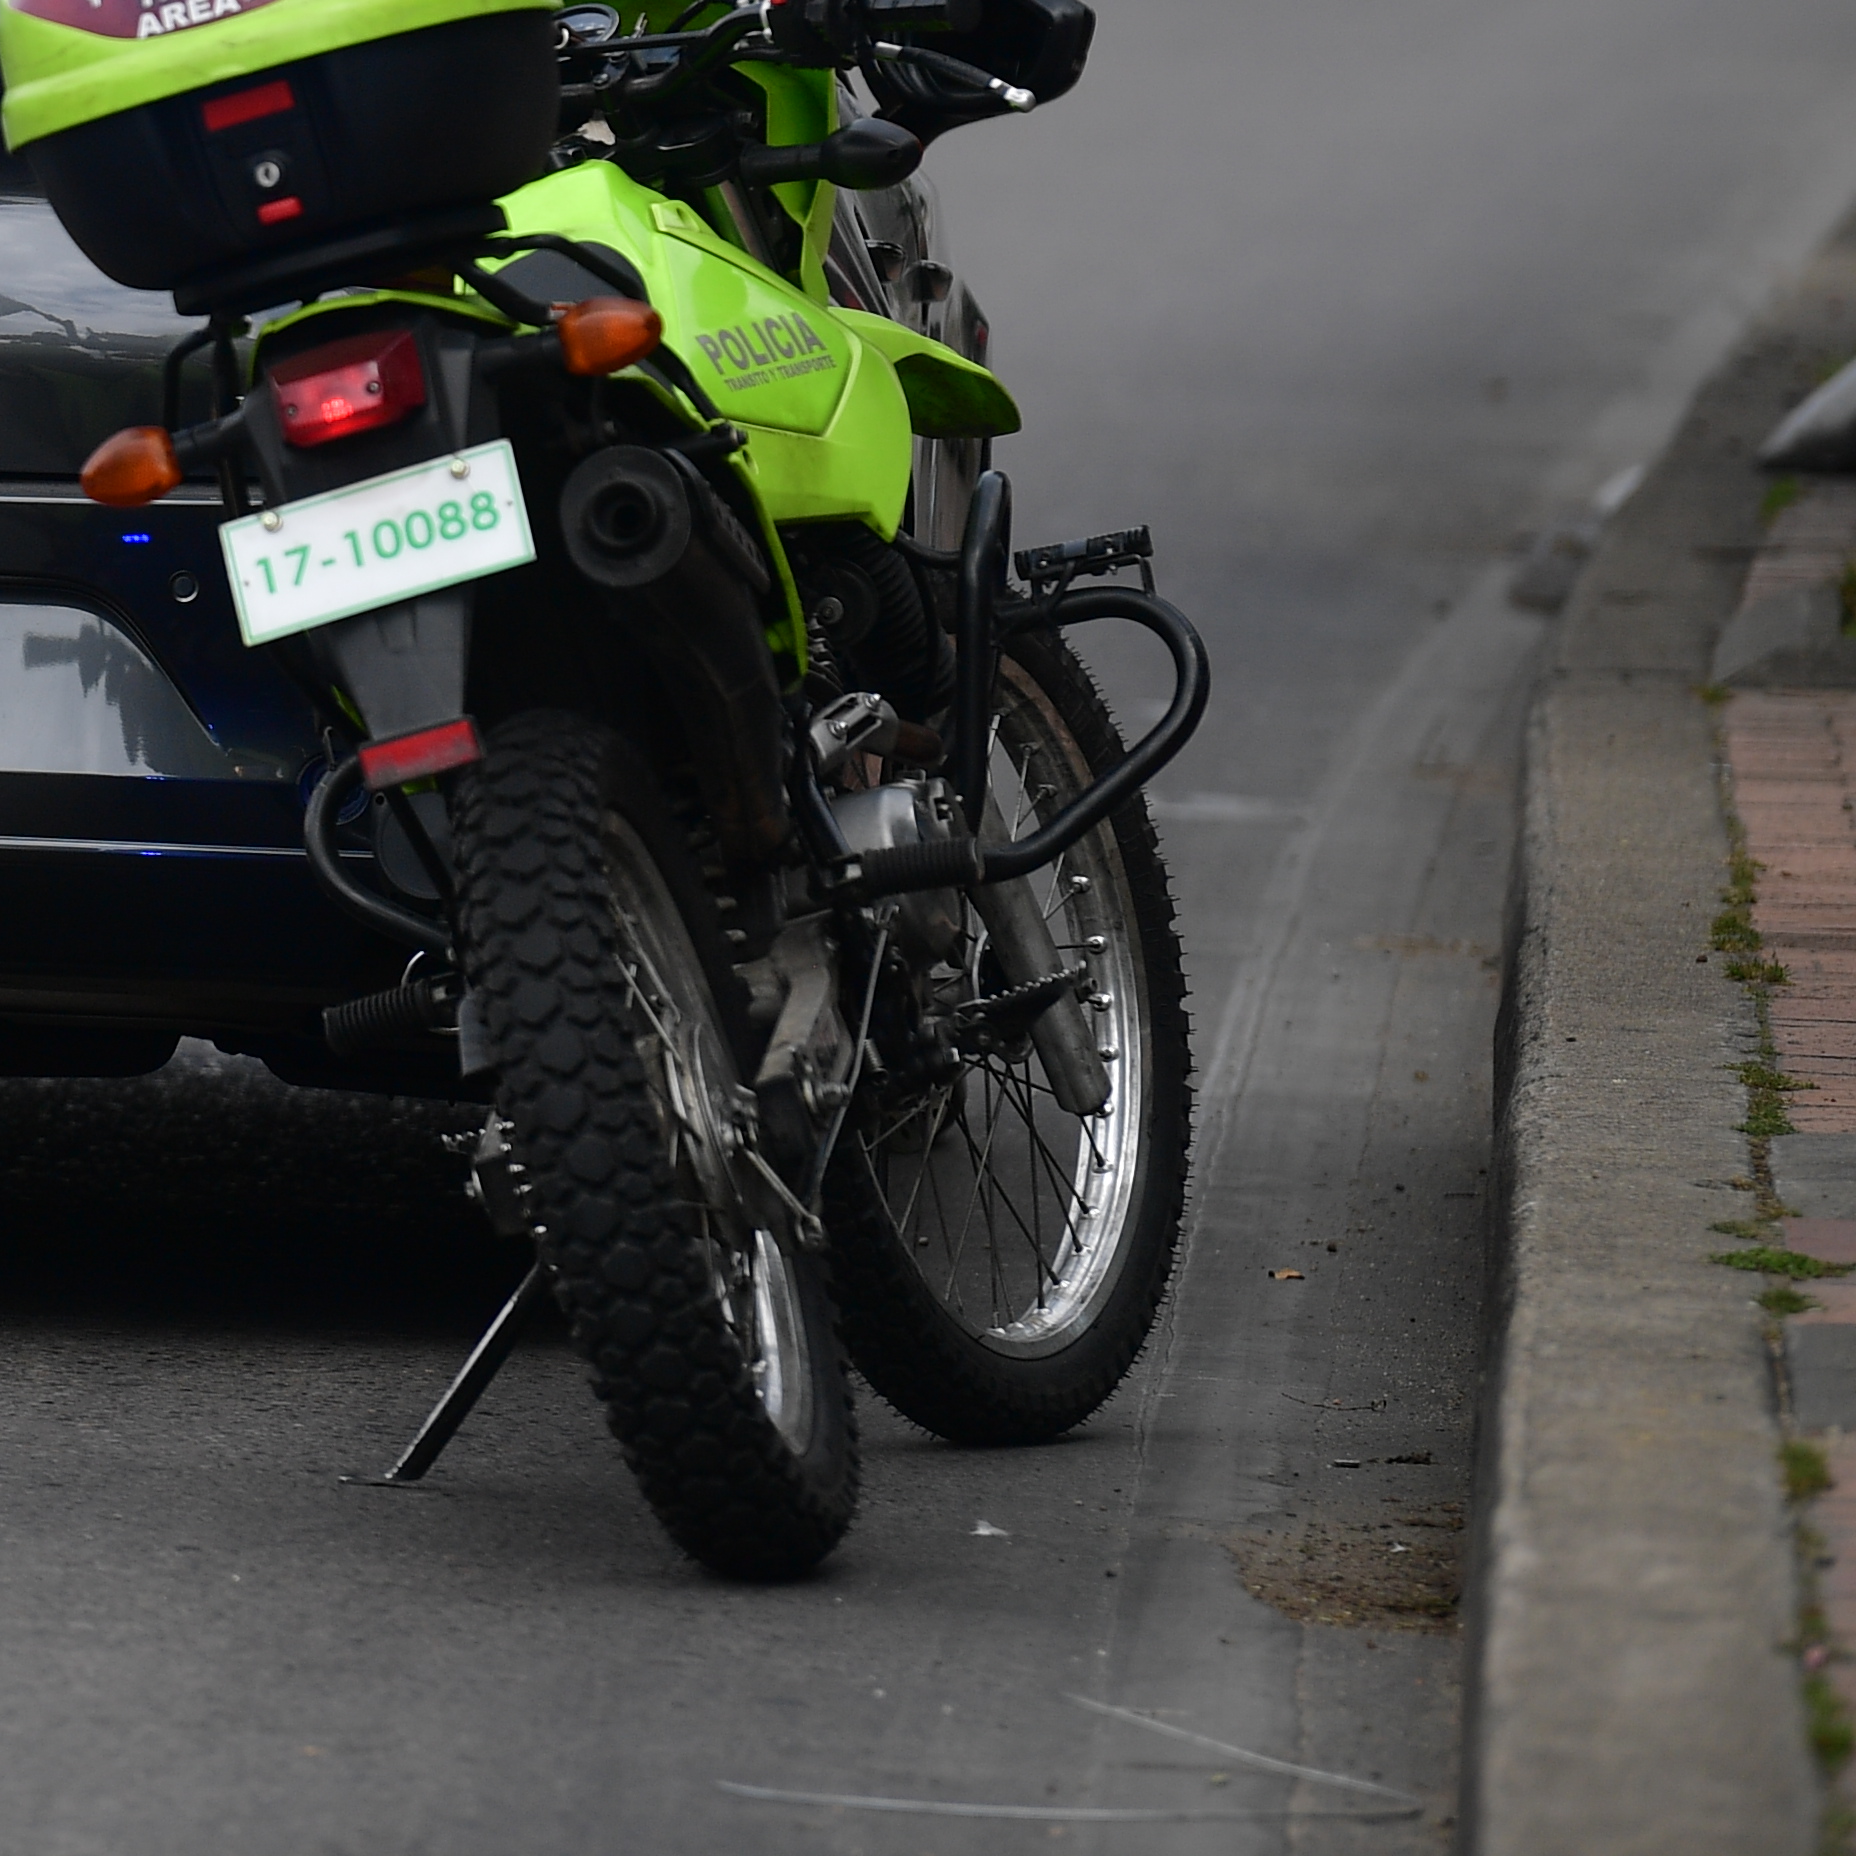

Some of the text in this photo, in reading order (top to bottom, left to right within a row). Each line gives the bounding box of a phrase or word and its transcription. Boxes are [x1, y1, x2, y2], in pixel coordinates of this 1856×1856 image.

[695, 311, 828, 376] POLICIA
[724, 354, 837, 392] TRANSITO Y TRANSPORTE
[256, 490, 500, 595] 17-10088
